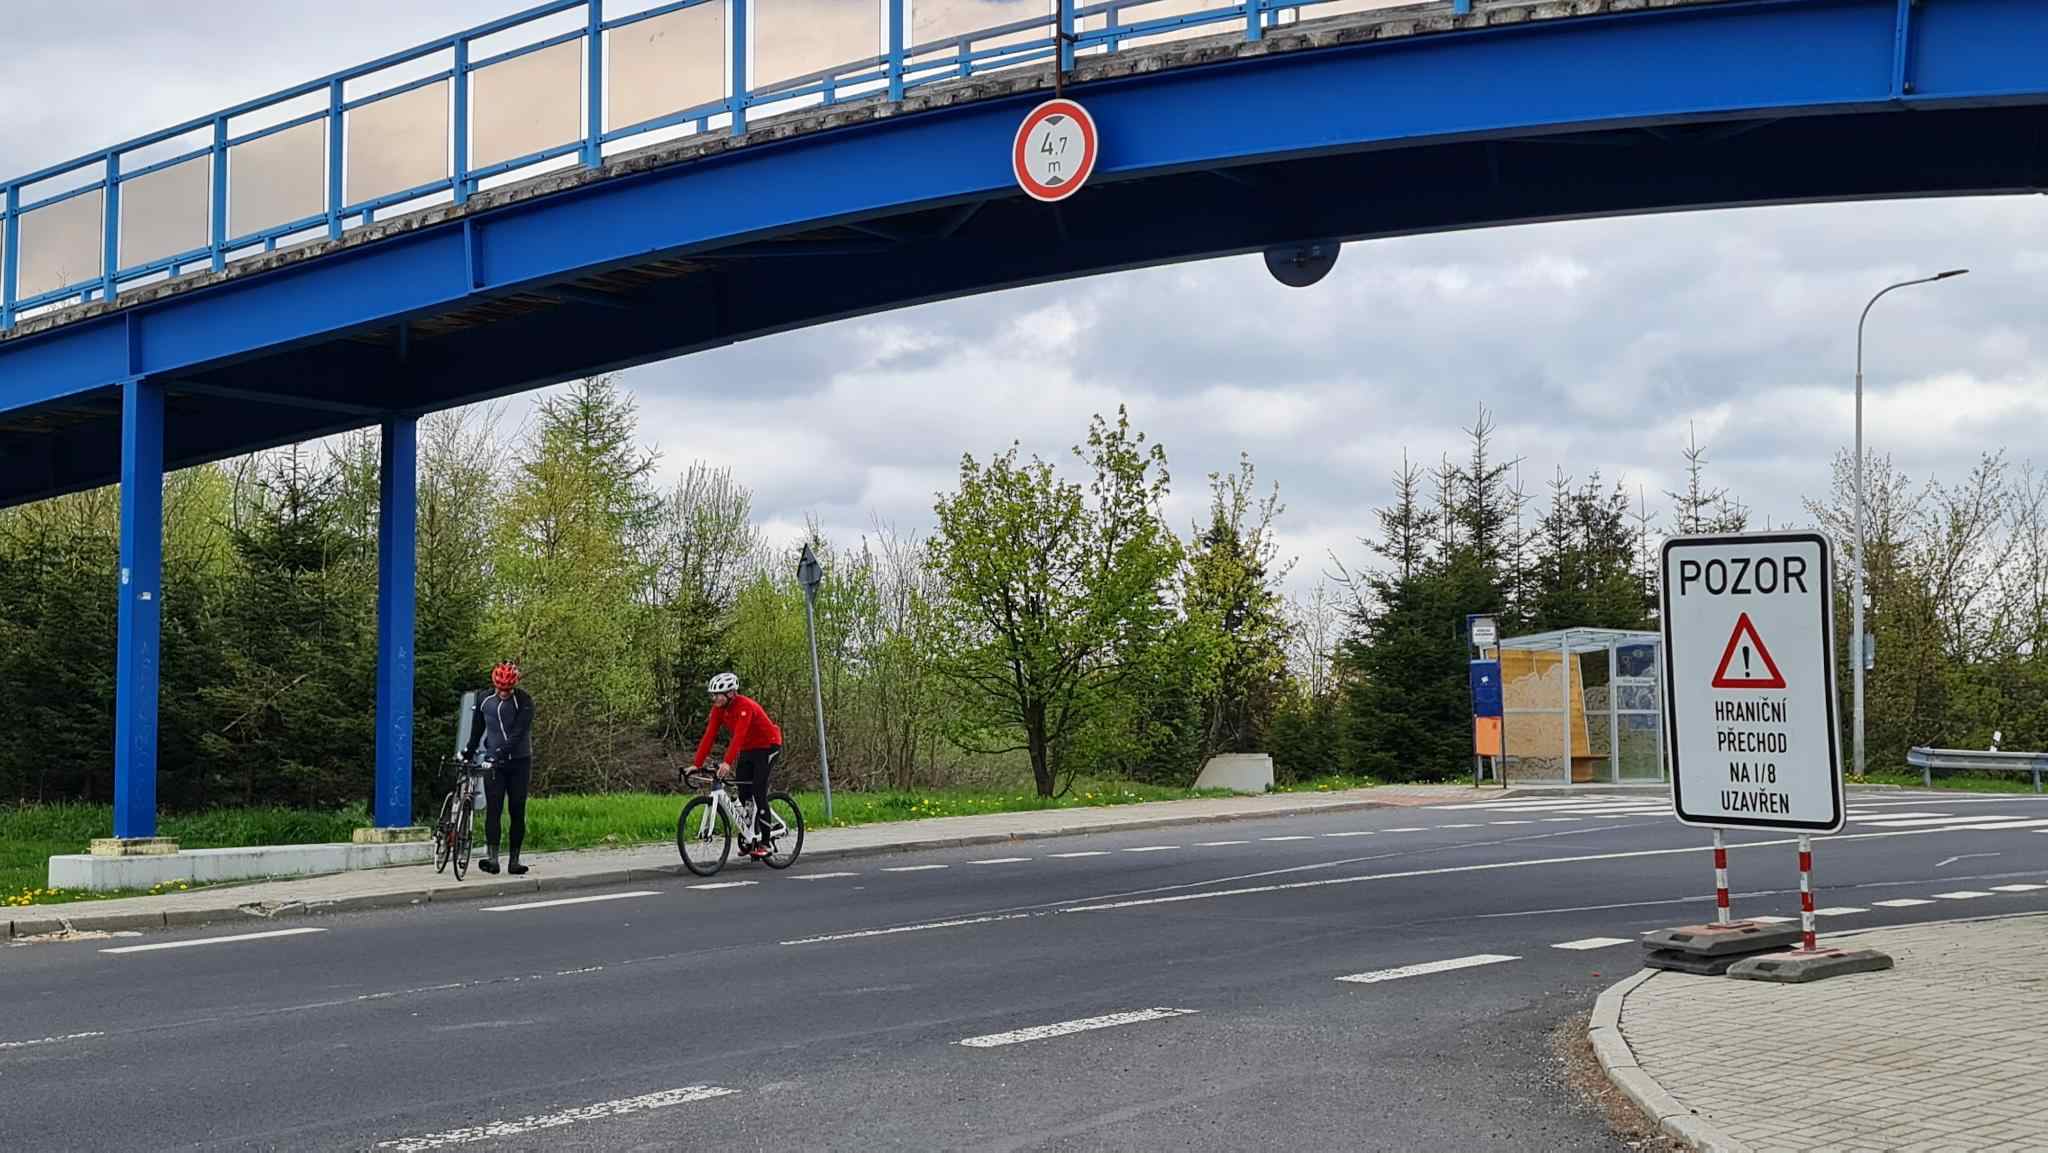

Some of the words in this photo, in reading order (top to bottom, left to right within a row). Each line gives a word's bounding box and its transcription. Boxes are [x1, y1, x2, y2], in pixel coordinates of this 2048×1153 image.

[1048, 160, 1061, 173] m
[1679, 556, 1808, 596] POZOR
[1714, 697, 1788, 723] HRANIČNÍ
[1717, 727, 1788, 753] PŘECHOD
[1729, 762, 1750, 784] NA
[1721, 788, 1790, 814] UZAVŘEN
